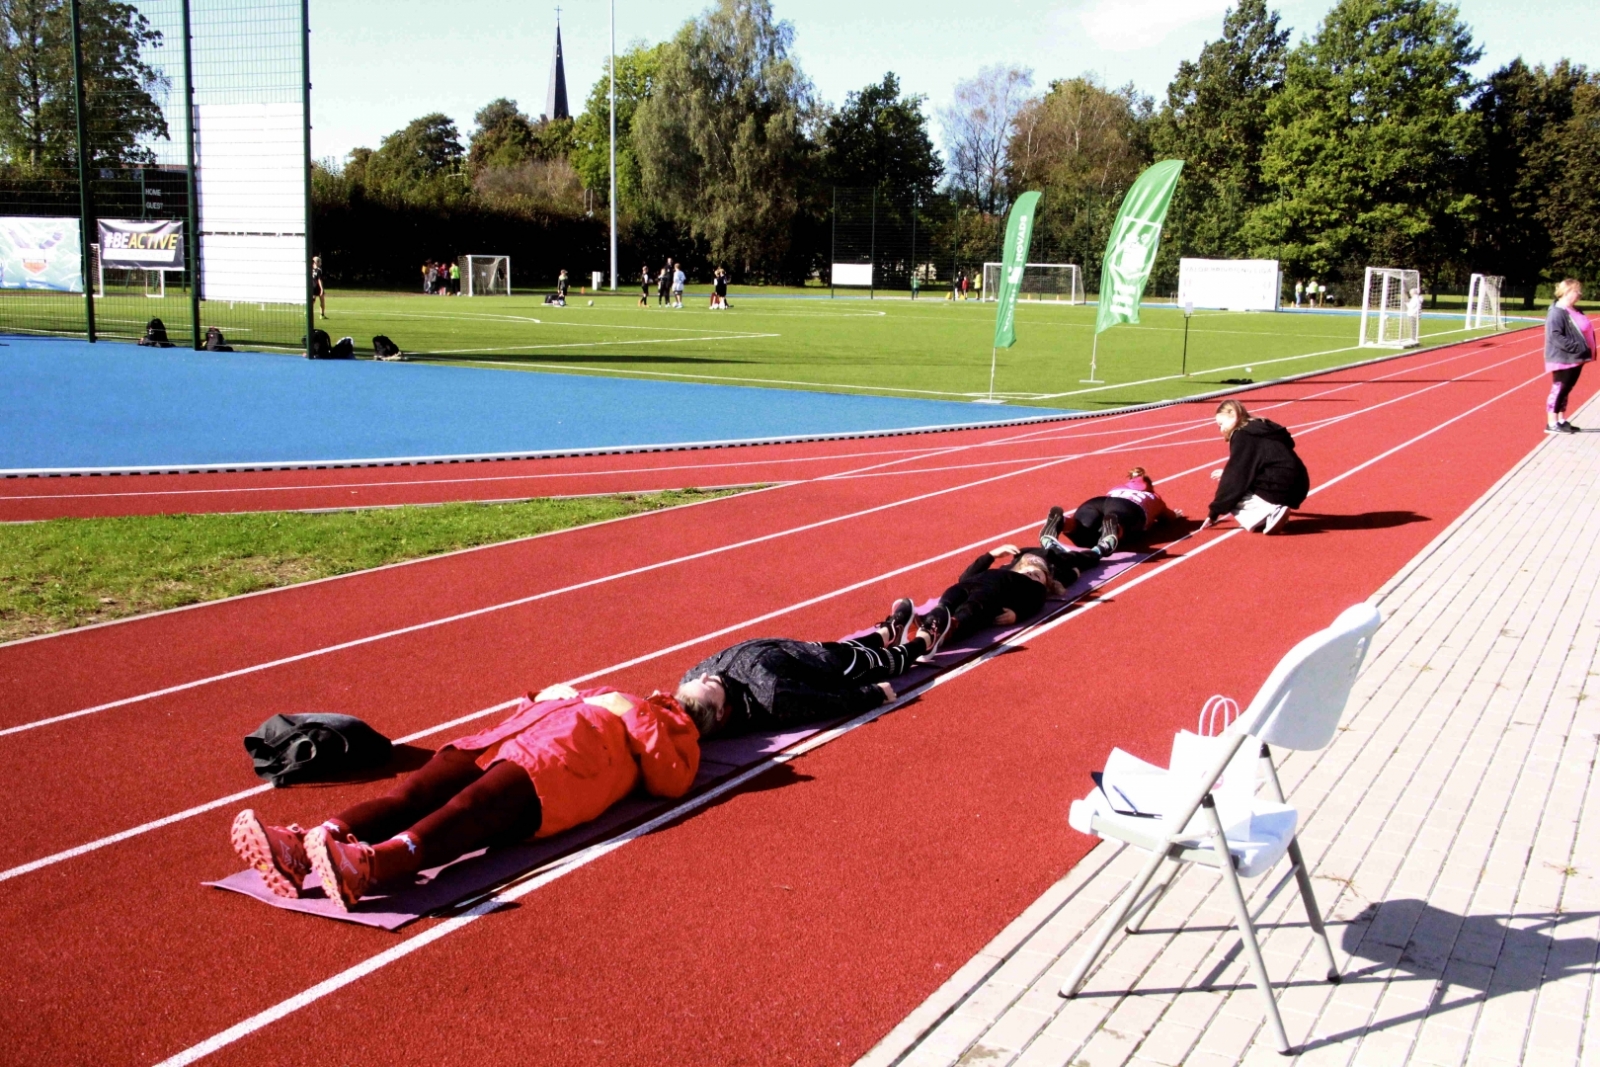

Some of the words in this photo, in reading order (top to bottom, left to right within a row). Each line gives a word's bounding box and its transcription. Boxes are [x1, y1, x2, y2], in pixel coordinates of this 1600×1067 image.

[145, 188, 161, 197] HOME
[104, 232, 179, 250] #BEACTIVE
[1015, 214, 1028, 262] NOVADS
